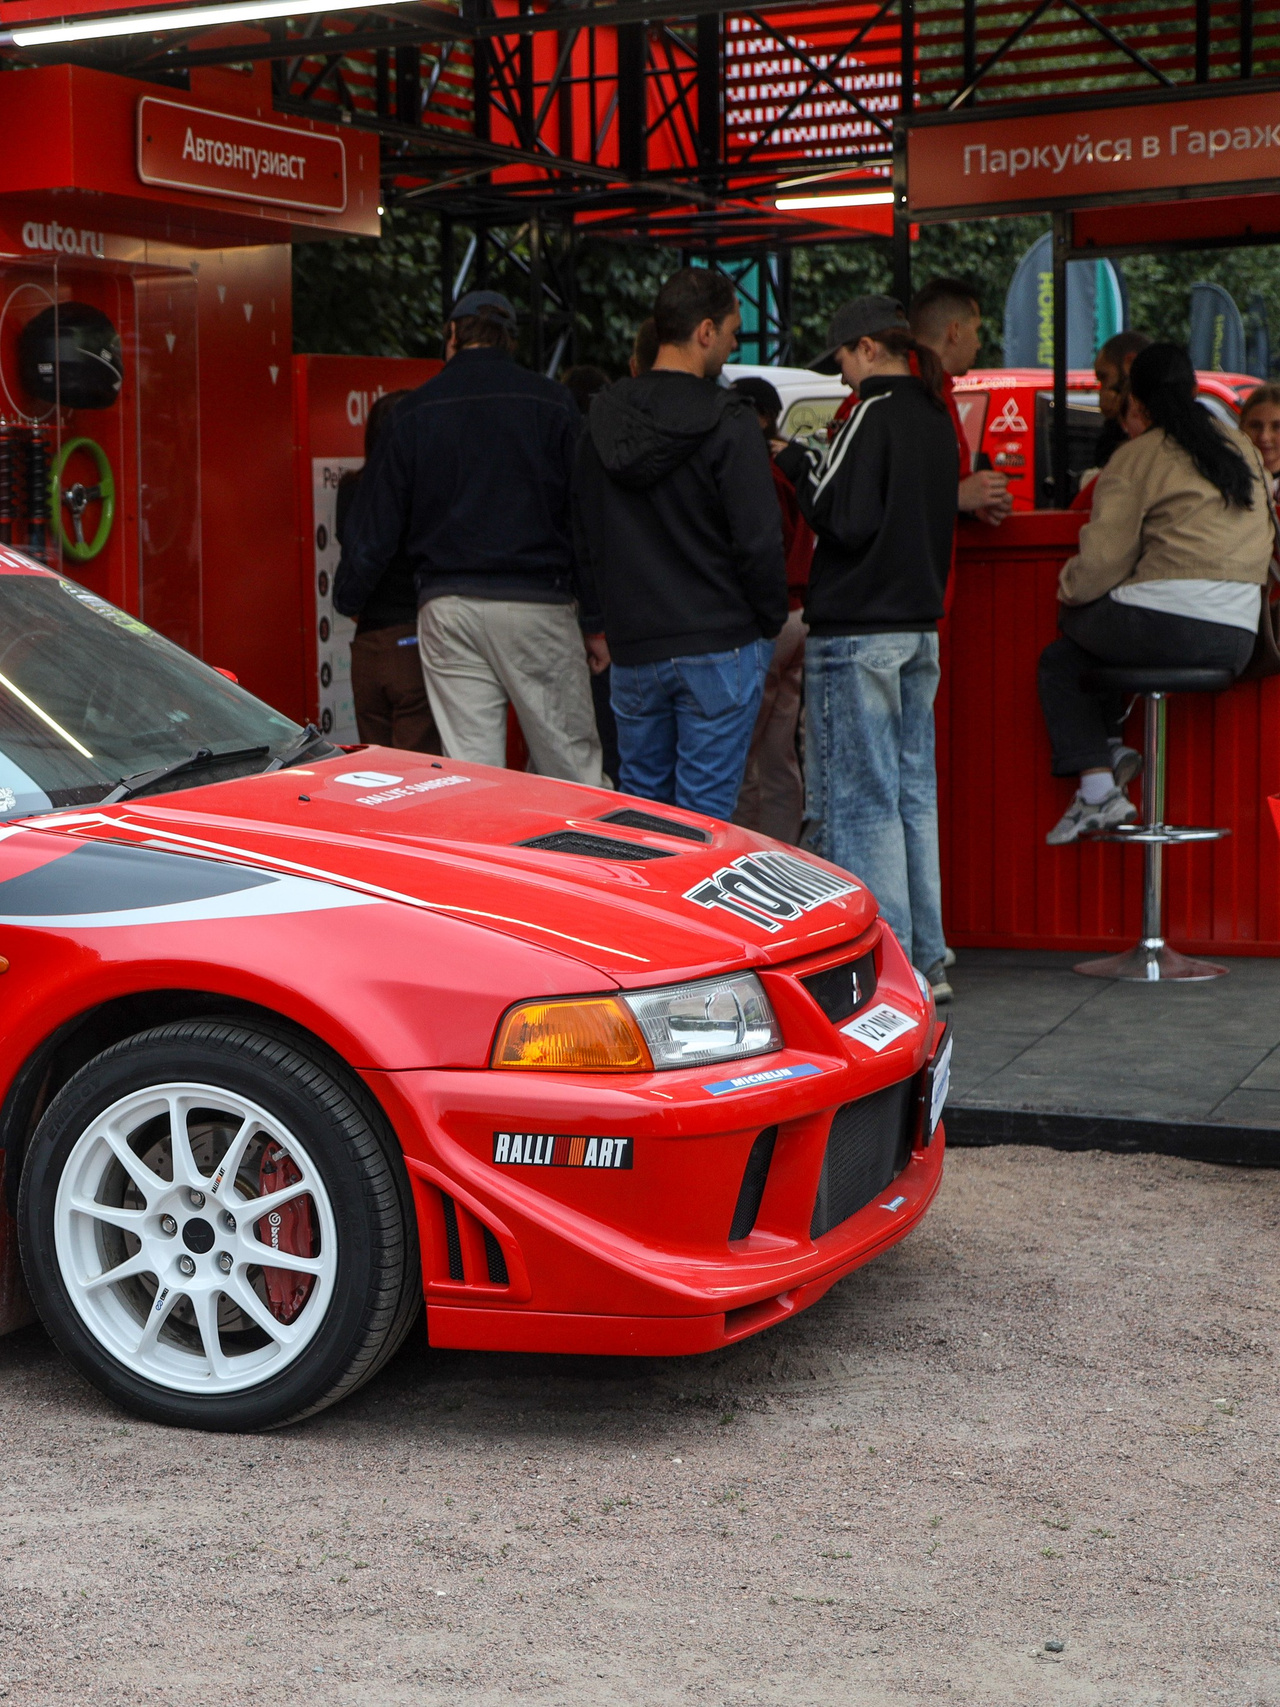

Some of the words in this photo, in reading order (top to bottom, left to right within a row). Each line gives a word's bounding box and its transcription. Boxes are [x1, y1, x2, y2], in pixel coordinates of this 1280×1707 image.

[182, 126, 306, 180] Автоэнтузиаст
[963, 133, 1133, 178] Паркуйся
[1141, 135, 1161, 159] в
[22, 220, 105, 258] auto.ru
[355, 788, 414, 806] RALLYE
[853, 1023, 887, 1042] V2
[730, 1068, 793, 1087] MICHELIN
[494, 1133, 554, 1165] RALLI
[583, 1137, 628, 1168] ART
